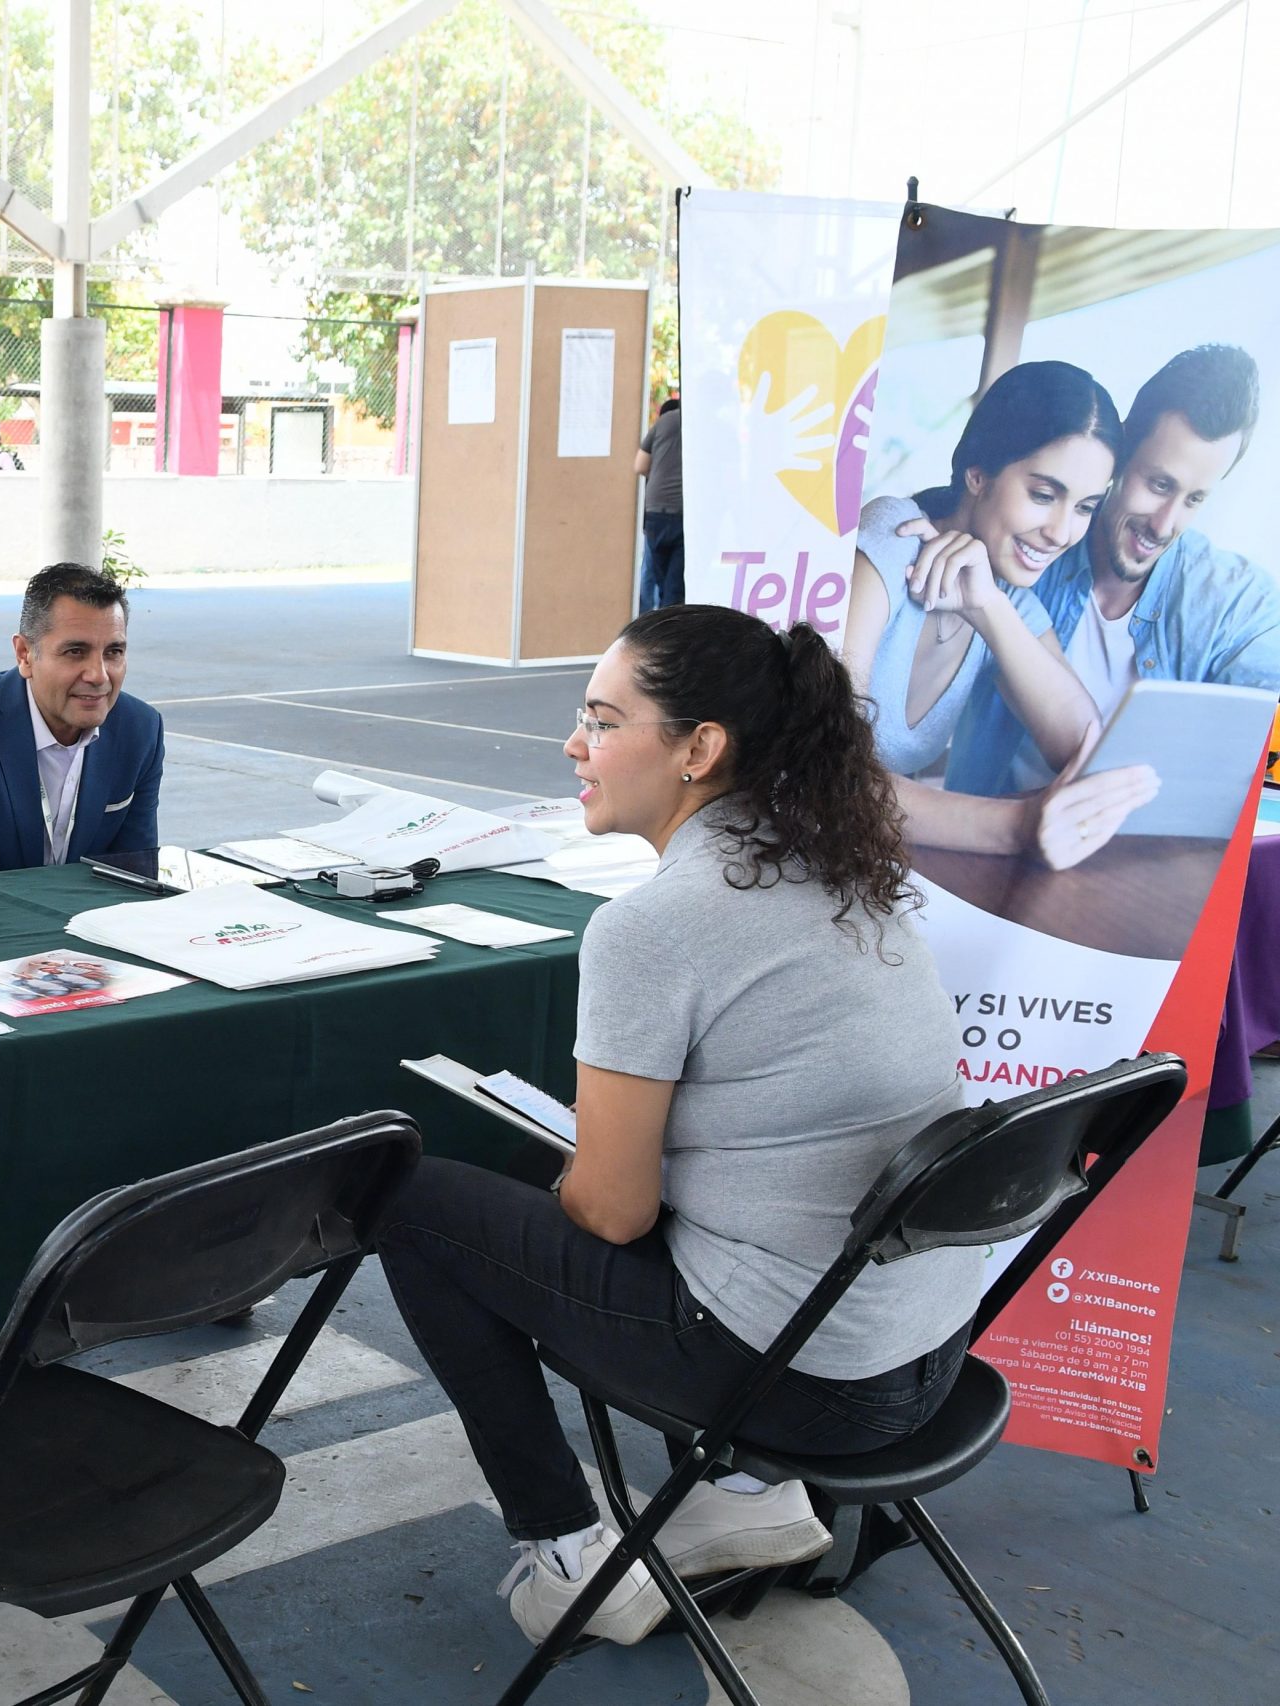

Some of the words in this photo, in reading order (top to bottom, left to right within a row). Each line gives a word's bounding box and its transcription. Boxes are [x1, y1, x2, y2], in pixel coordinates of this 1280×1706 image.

[721, 551, 847, 634] Tele
[954, 993, 971, 1015] Y
[977, 993, 1007, 1016] SI
[1018, 995, 1113, 1025] VIVES
[962, 1025, 987, 1048] O
[997, 1028, 1022, 1051] O
[1078, 1269, 1161, 1294] /XXIBanorte
[1071, 1292, 1157, 1317] @XXIBanorte
[1055, 1330, 1071, 1341] (01
[1074, 1333, 1092, 1345] 55)
[1094, 1337, 1124, 1350] 2000
[1126, 1343, 1150, 1357] 1994
[1070, 1318, 1152, 1346] ¡Llámanos!
[989, 1332, 1020, 1345] Lunes
[1022, 1338, 1029, 1346] a
[1031, 1338, 1068, 1352] viernes
[1071, 1345, 1085, 1355] de
[1086, 1347, 1094, 1356] 8
[1095, 1351, 1112, 1360] am
[1114, 1354, 1121, 1362] a
[1123, 1355, 1130, 1363] 7
[1131, 1358, 1149, 1369] pm
[1020, 1347, 1064, 1363] Sábados
[1067, 1356, 1080, 1365] de
[1083, 1358, 1090, 1367] 9
[1093, 1362, 1109, 1371] am
[1111, 1365, 1118, 1373] a
[1121, 1366, 1128, 1375] 2
[1130, 1369, 1148, 1380] pm
[1022, 1359, 1031, 1369] la
[1033, 1361, 1056, 1374] App
[1058, 1365, 1117, 1384] AforeMóvil
[1119, 1377, 1147, 1392] XXIB
[1019, 1381, 1029, 1390] tu
[1029, 1384, 1058, 1395] Cuenta
[1060, 1388, 1101, 1403] Individual
[1102, 1397, 1117, 1407] son
[1058, 1398, 1143, 1422] www.gob.mx/consar
